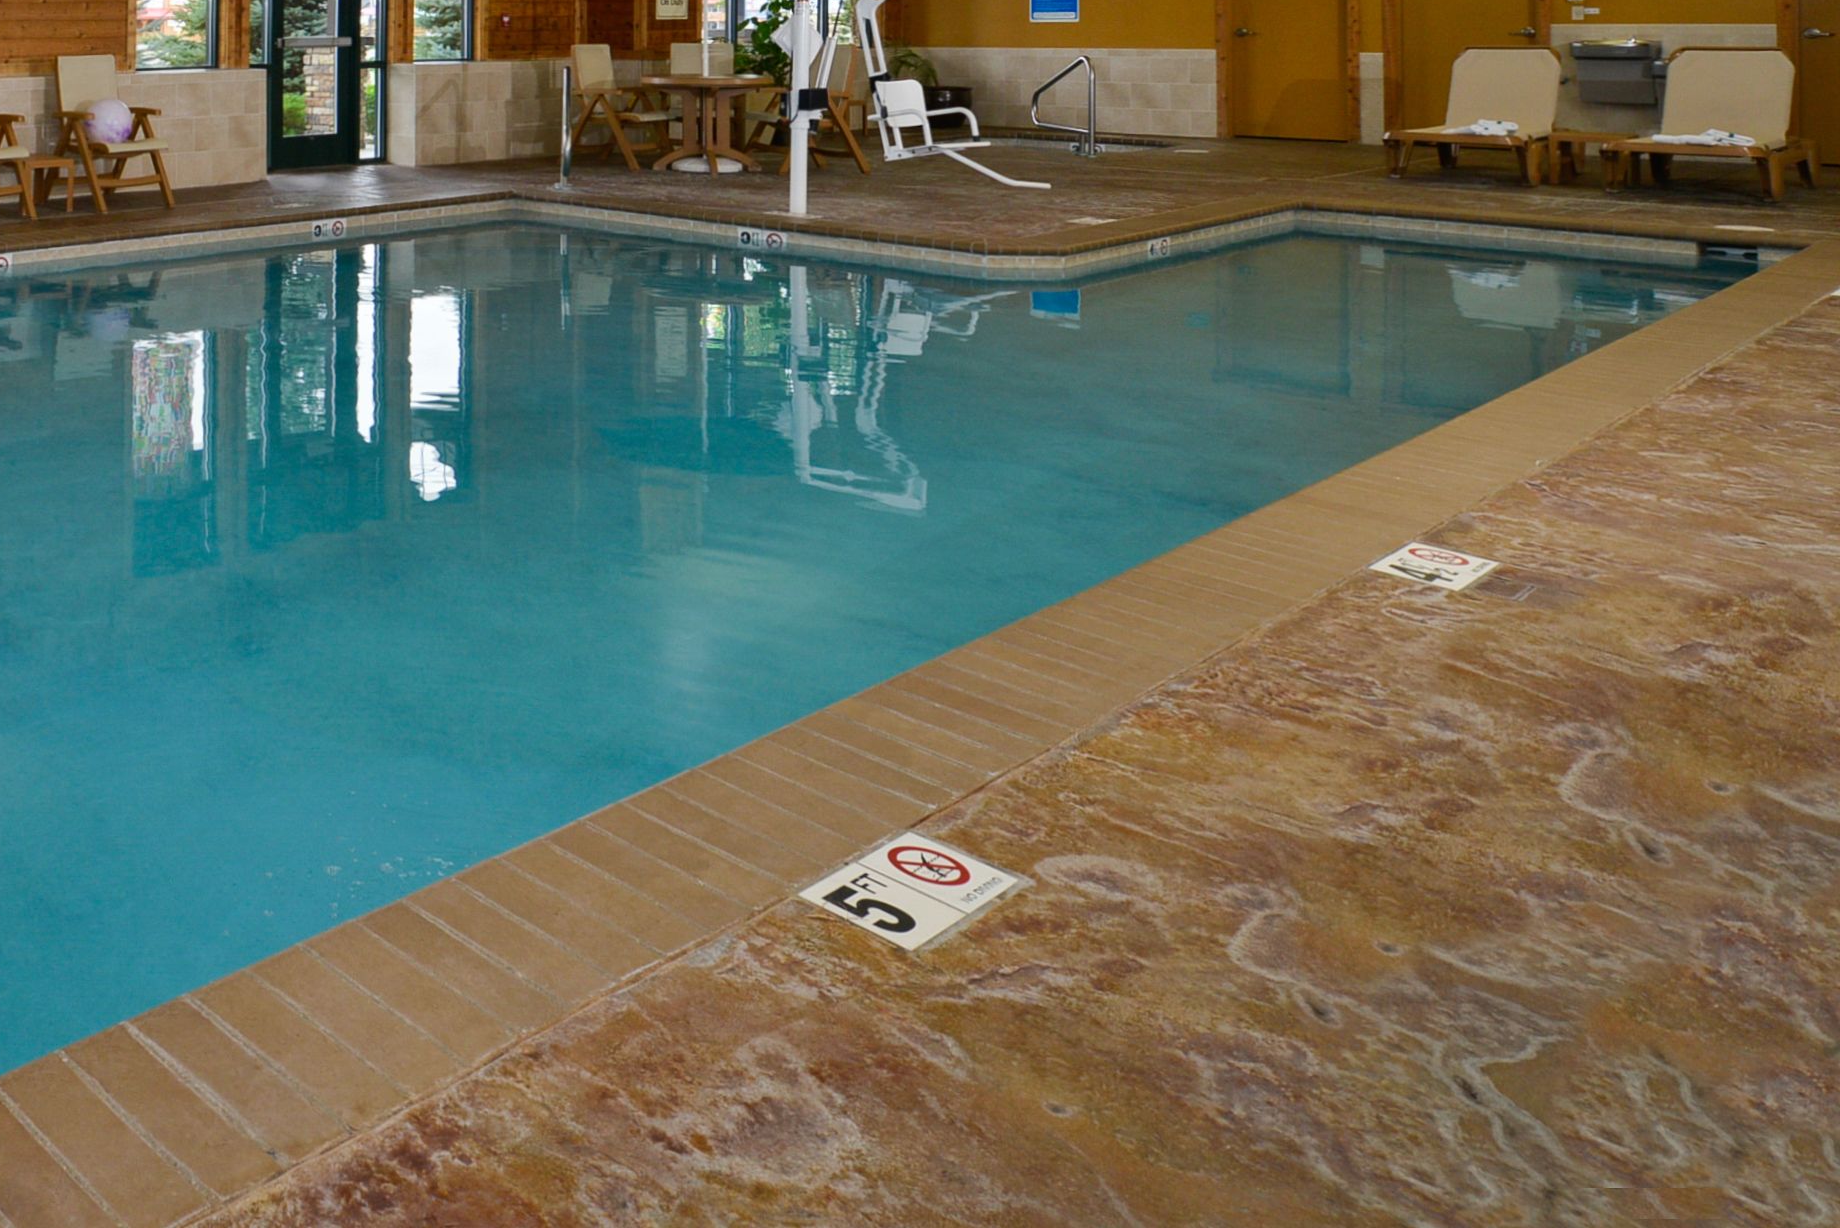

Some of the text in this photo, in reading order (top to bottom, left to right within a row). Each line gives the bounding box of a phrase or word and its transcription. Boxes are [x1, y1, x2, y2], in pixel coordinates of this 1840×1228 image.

[1389, 564, 1454, 582] 4
[823, 873, 916, 933] 5 FT
[961, 877, 1003, 904] NO DIVING
